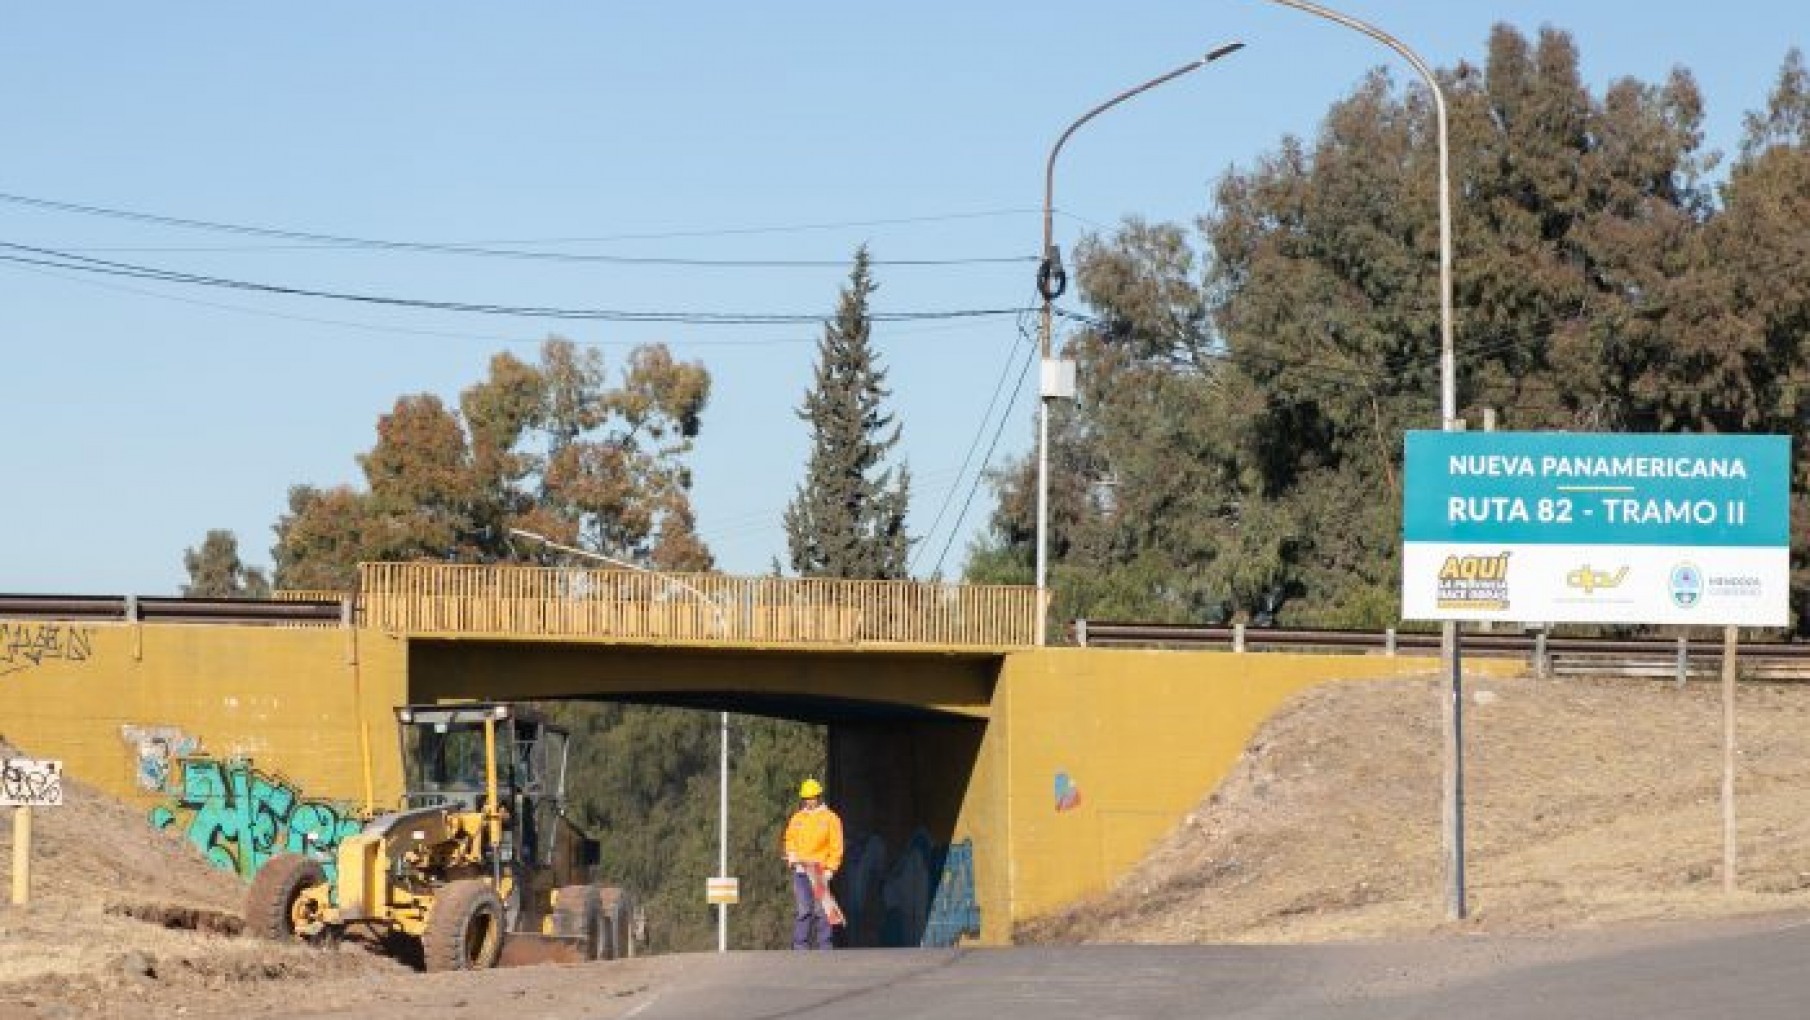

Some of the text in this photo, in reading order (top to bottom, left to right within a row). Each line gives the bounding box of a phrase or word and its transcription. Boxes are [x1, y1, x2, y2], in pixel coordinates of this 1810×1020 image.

[1449, 455, 1747, 478] NUEVA PANAMERICANA
[1448, 496, 1529, 523] RUTA
[1537, 498, 1573, 523] 82
[1602, 499, 1718, 524] TRAMO
[1727, 501, 1744, 526] II
[1438, 551, 1510, 581] AQUÍ
